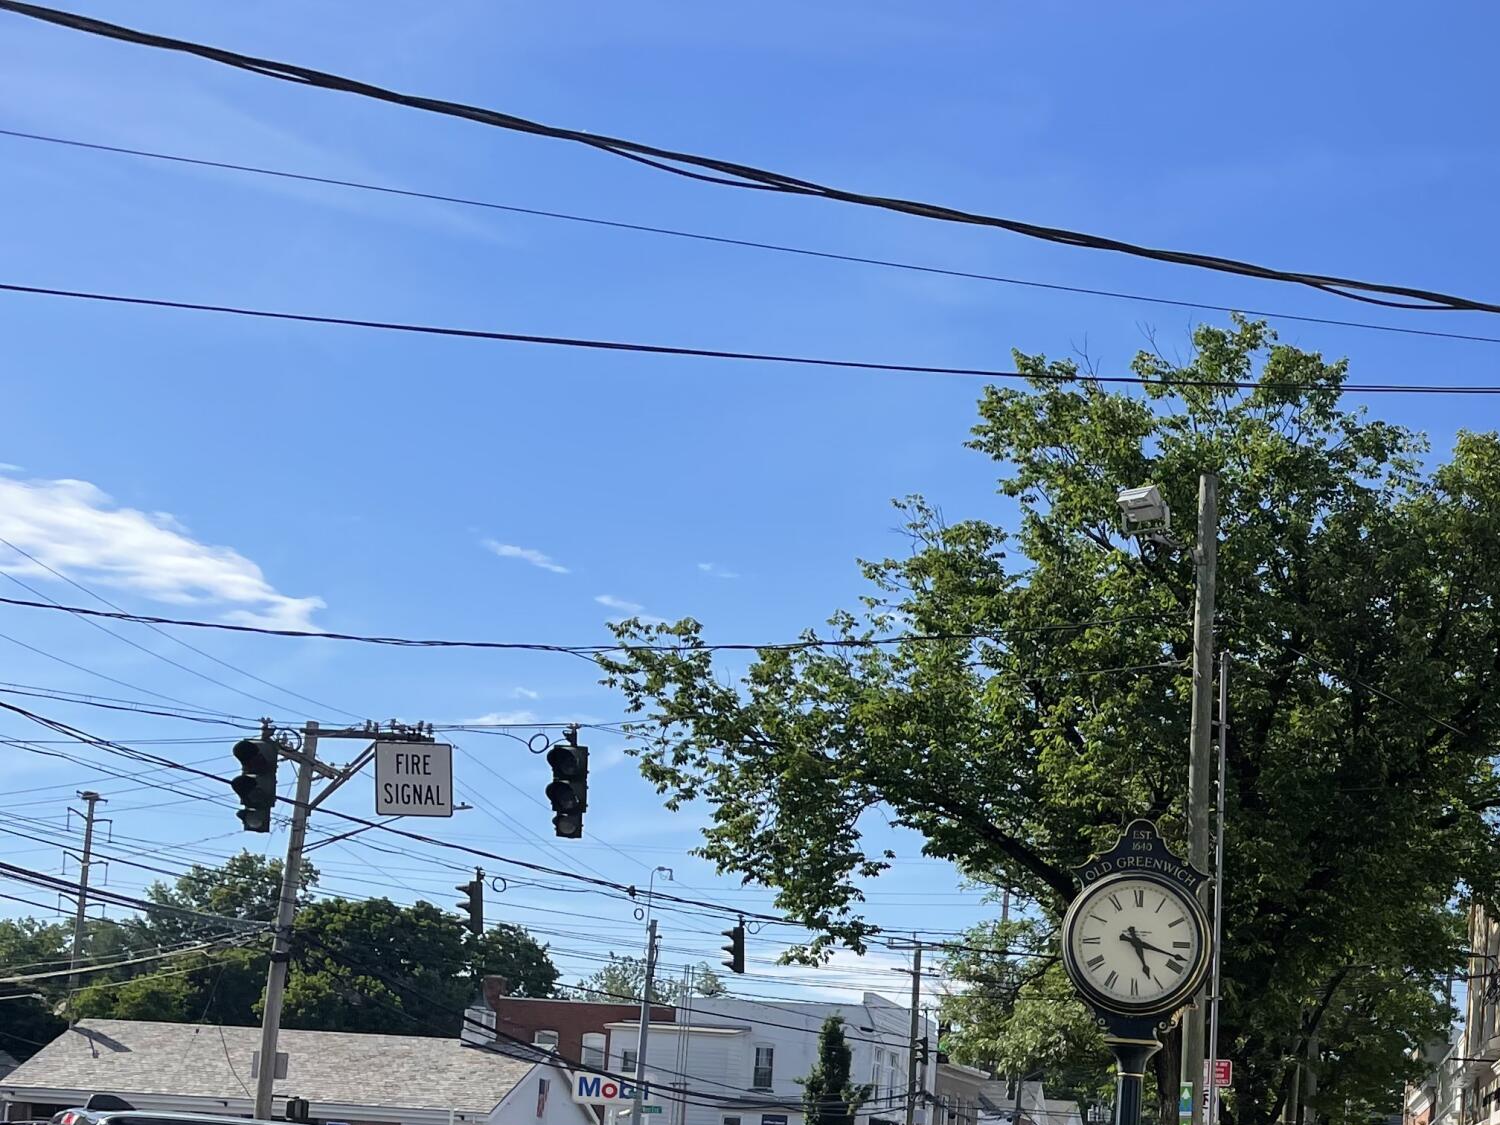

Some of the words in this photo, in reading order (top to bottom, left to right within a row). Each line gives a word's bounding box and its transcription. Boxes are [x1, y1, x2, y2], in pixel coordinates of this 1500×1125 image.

[396, 753, 432, 776] FIRE
[384, 783, 445, 806] SIGNAL
[1132, 830, 1153, 840] EST.
[1085, 861, 1112, 881] OLD
[1116, 856, 1196, 887] GREENWICH
[578, 1076, 649, 1101] Mobl
